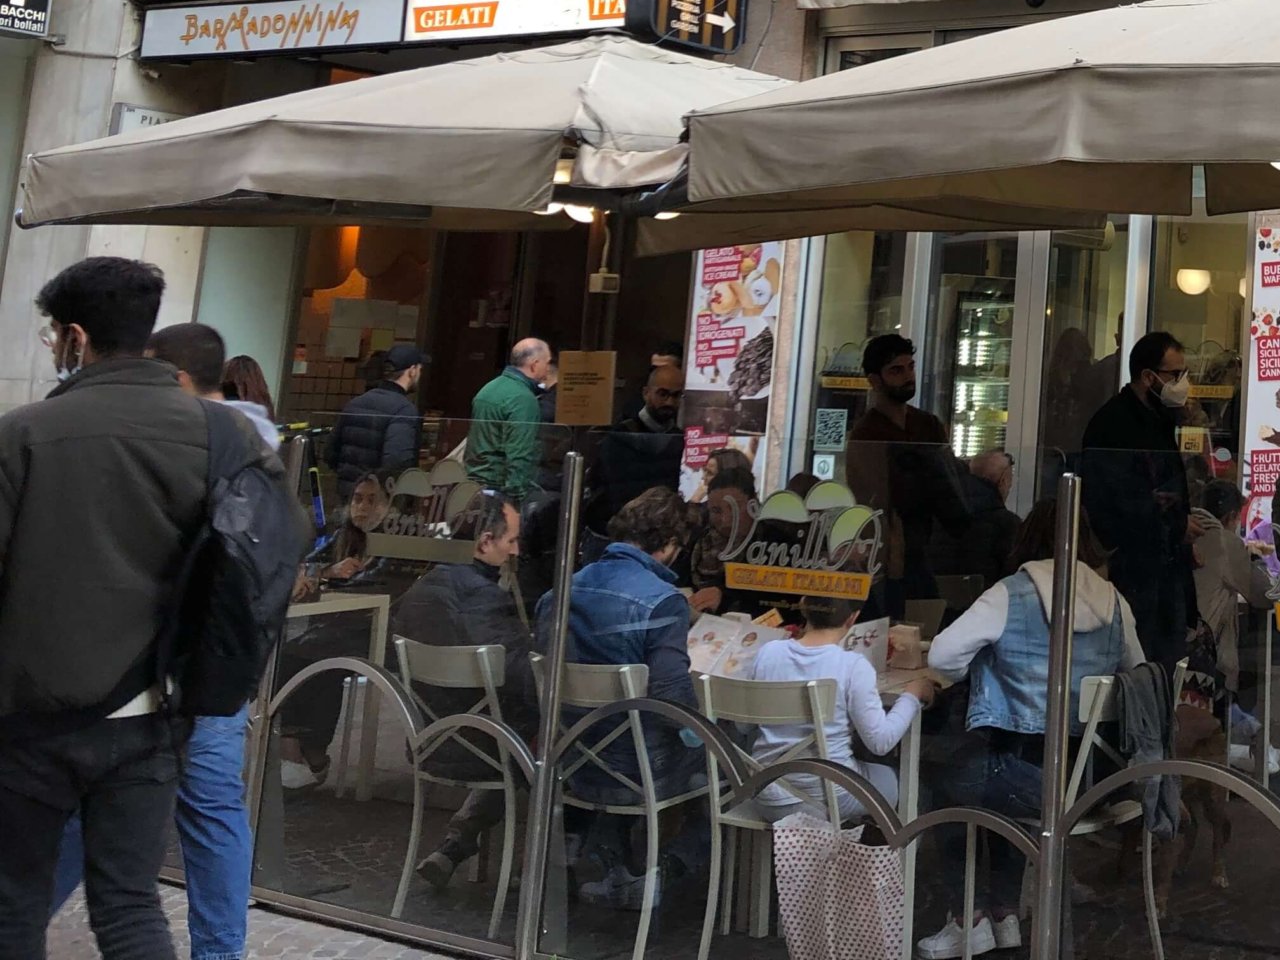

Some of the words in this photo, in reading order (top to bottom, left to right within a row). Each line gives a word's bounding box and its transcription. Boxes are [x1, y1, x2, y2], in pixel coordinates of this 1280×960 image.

[419, 6, 492, 29] GELATI
[1253, 483, 1271, 493] AND
[732, 567, 788, 589] GELATI
[791, 572, 863, 596] ITALIANI
